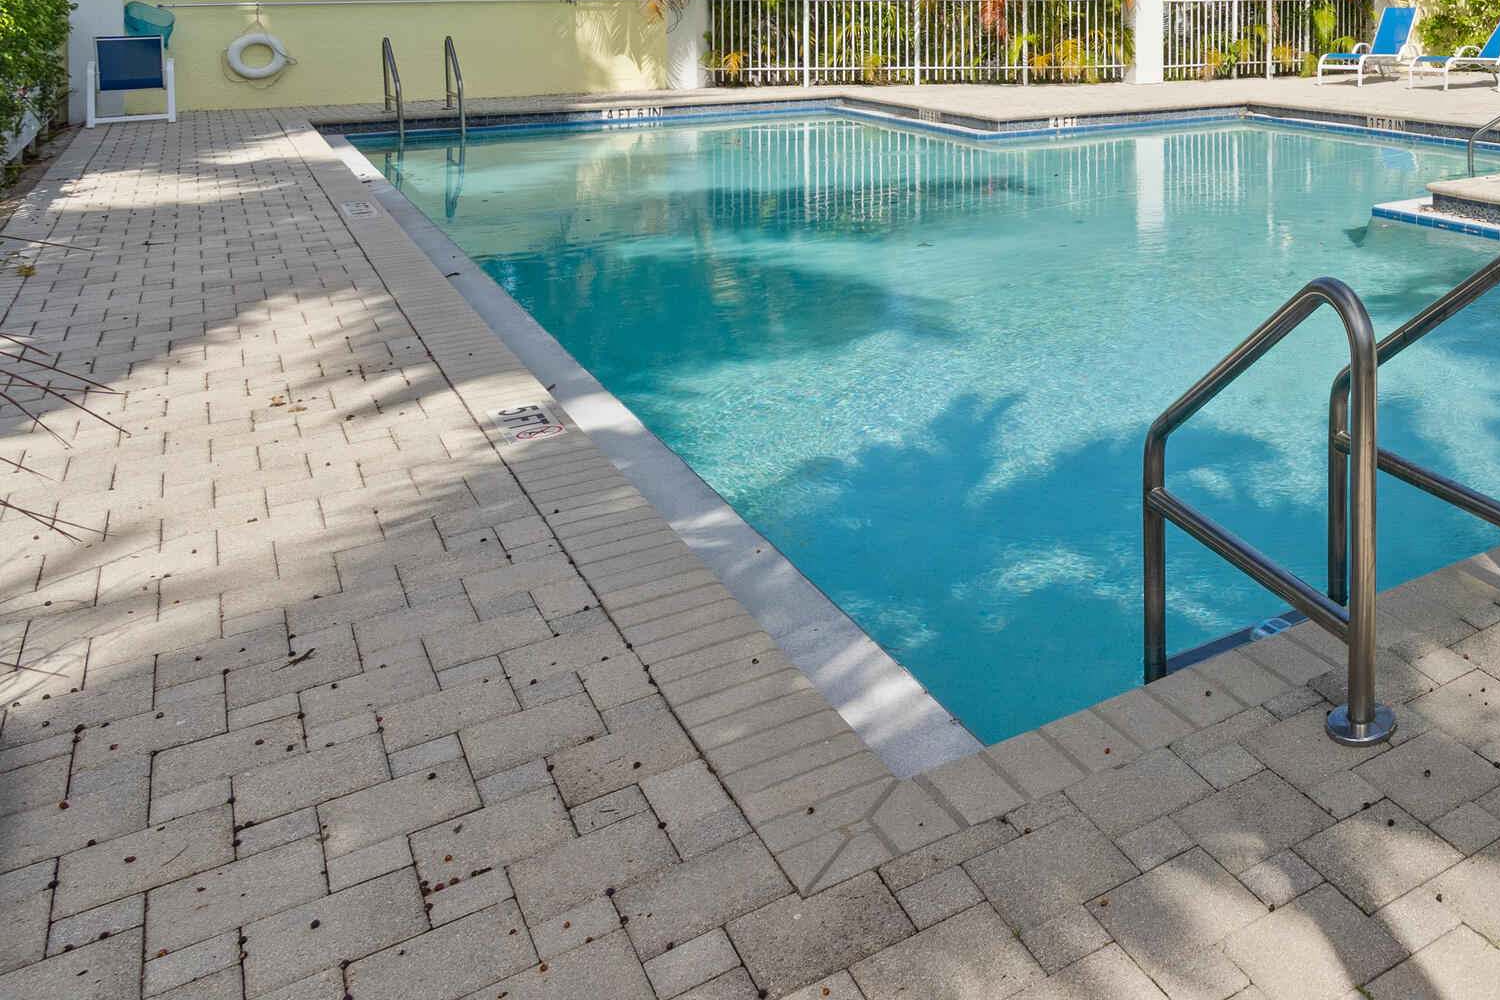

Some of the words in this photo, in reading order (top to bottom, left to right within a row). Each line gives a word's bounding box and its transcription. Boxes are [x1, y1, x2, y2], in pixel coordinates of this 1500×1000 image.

[607, 109, 614, 119] 4
[619, 108, 632, 118] FT
[638, 108, 643, 118] 6
[649, 107, 662, 117] IN
[1053, 116, 1059, 127] 4
[1063, 116, 1075, 127] FT
[1376, 118, 1385, 128] FT
[1395, 119, 1404, 131] IN
[498, 405, 539, 416] 5
[503, 413, 550, 429] FT
